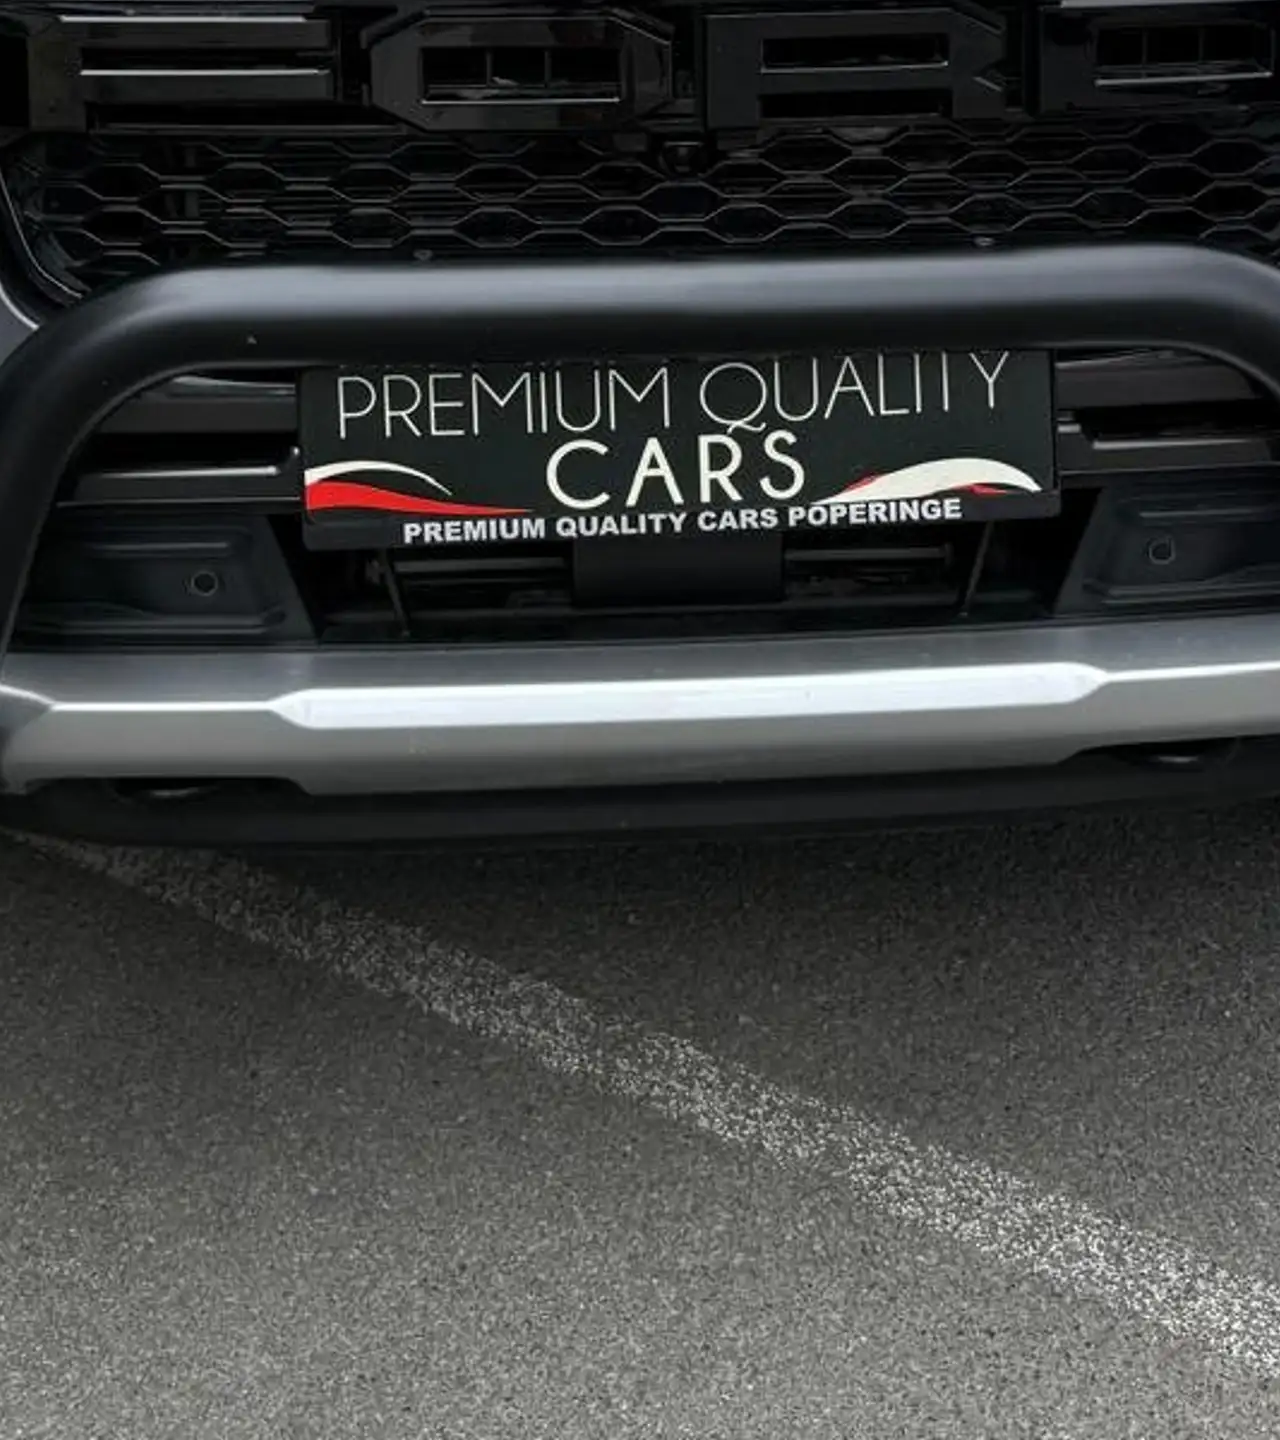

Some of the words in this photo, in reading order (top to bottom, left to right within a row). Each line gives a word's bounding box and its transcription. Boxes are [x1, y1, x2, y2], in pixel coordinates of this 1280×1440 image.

[337, 366, 670, 439] PREMIUM
[545, 429, 806, 510] CARS
[404, 517, 546, 544] PREMIUM
[556, 513, 687, 537] QUALITY
[697, 508, 779, 531] CARS
[787, 498, 963, 527] POPERINGE
